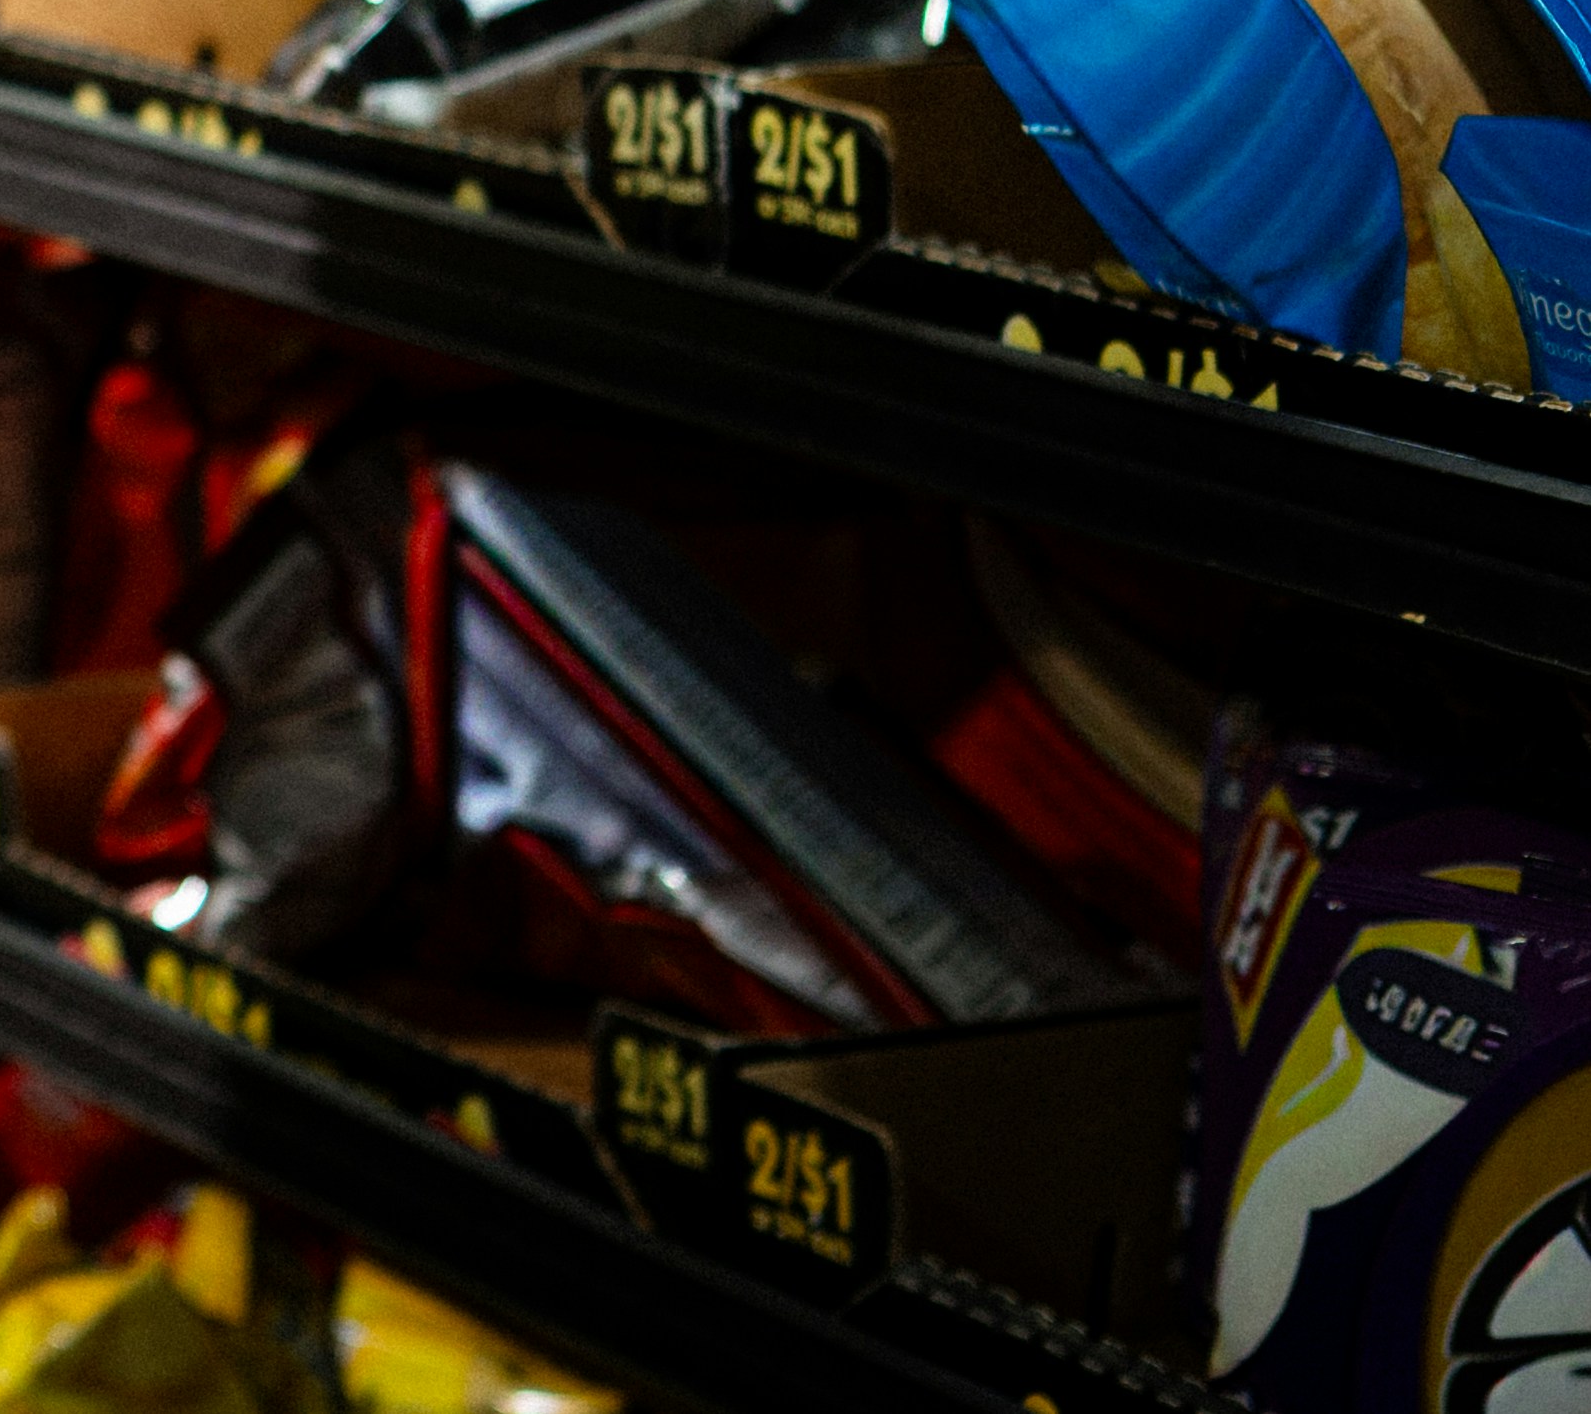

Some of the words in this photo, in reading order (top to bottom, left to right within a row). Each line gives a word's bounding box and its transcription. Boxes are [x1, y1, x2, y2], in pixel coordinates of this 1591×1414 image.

[605, 80, 707, 173] 2/$1
[750, 105, 857, 206] 2/$1
[744, 1119, 850, 1233] 2/$1
